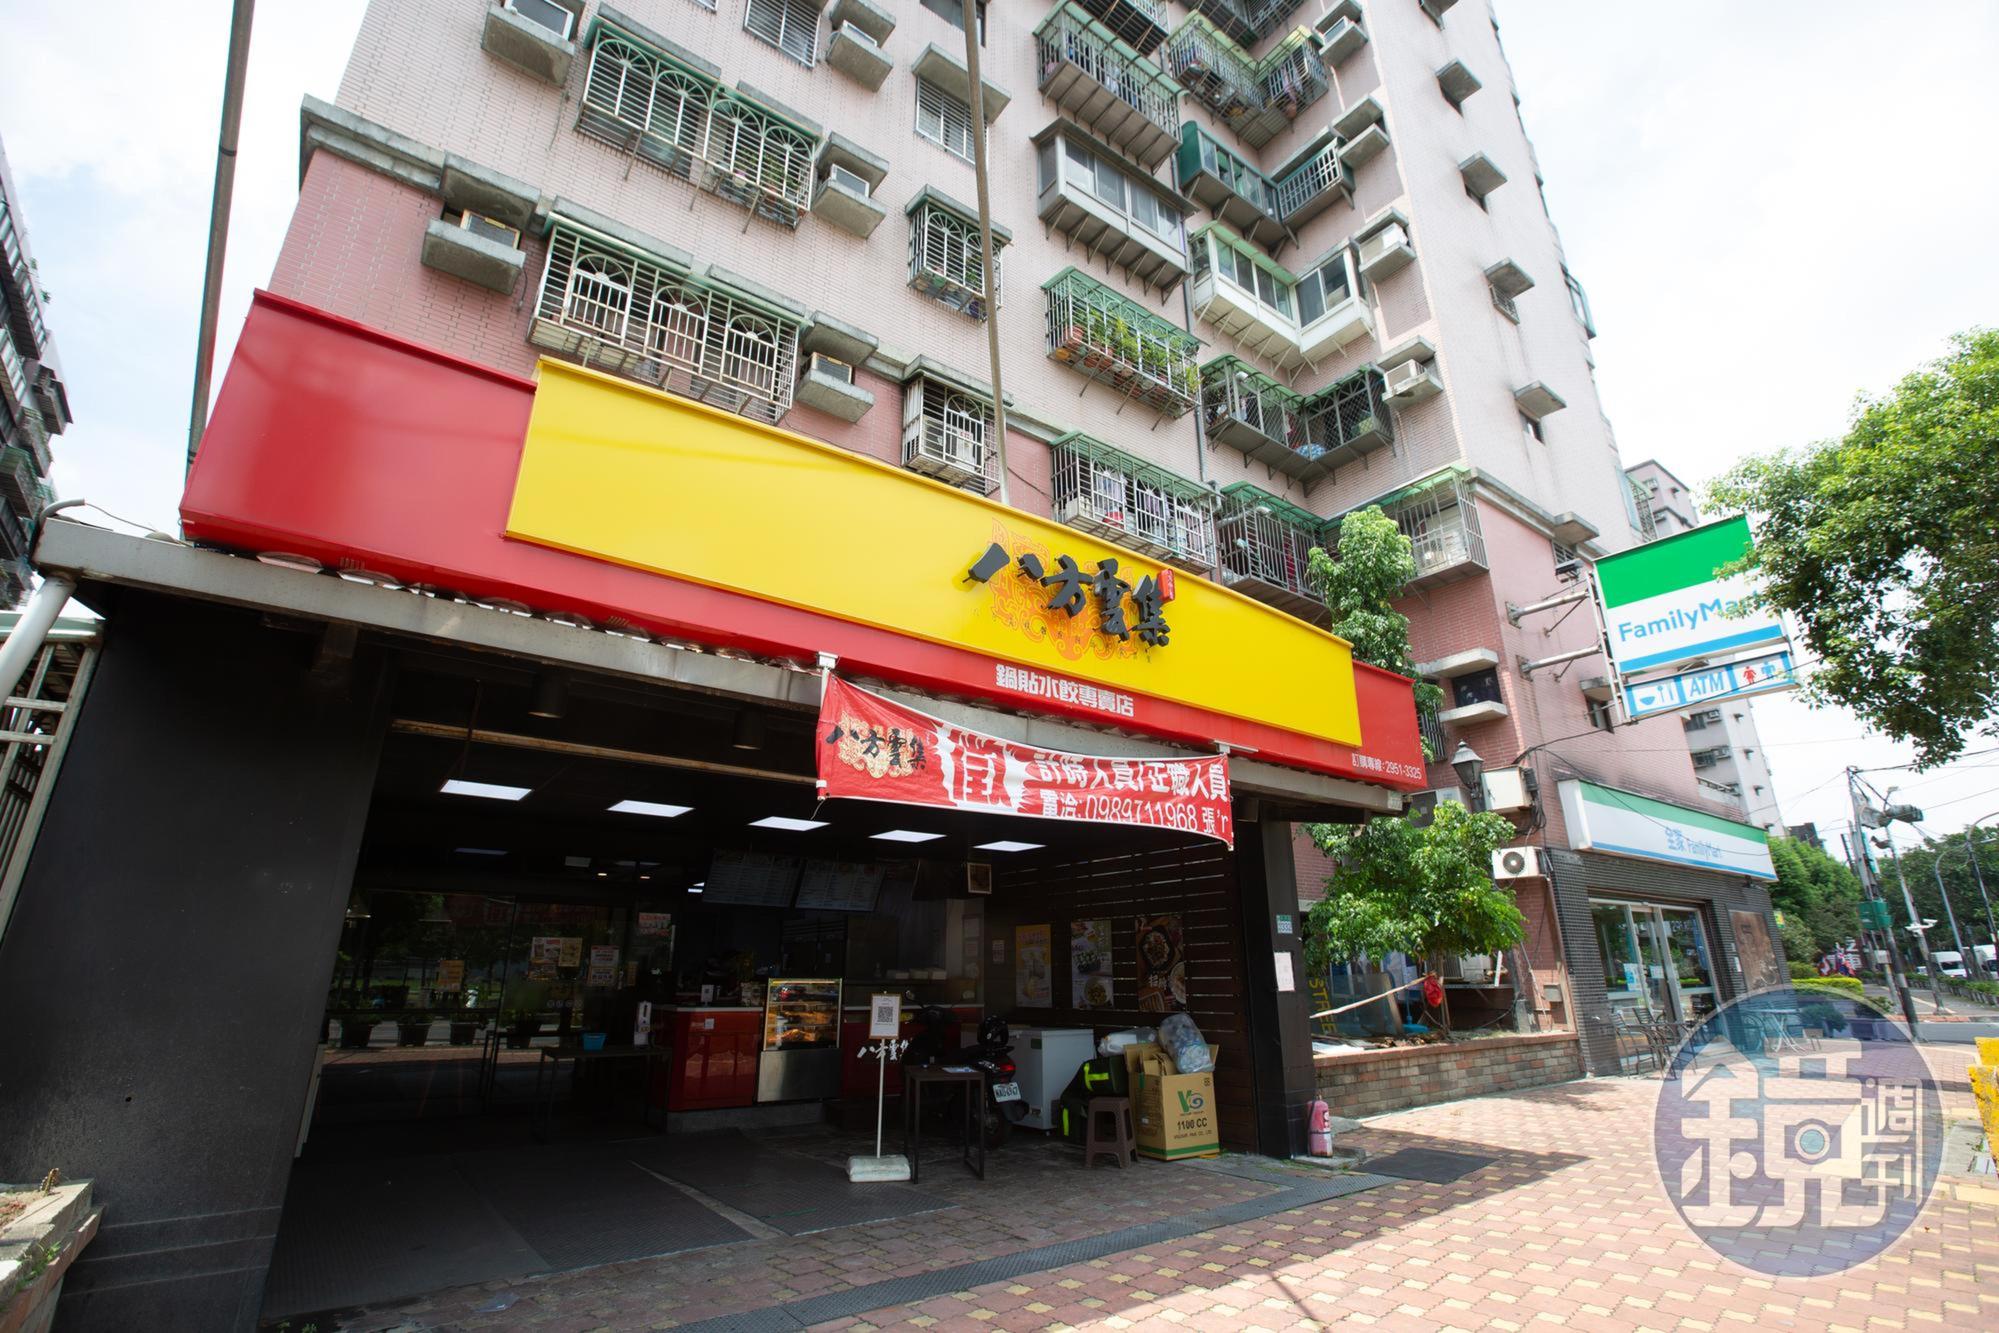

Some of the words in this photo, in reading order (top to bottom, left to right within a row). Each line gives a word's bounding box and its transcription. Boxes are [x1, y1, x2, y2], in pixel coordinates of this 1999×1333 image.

[967, 543, 1171, 648] 八方雲集
[995, 664, 1134, 718] 鍋貼水餃專賣店
[1690, 672, 1724, 697] ATM
[826, 725, 927, 770] 八方雲集
